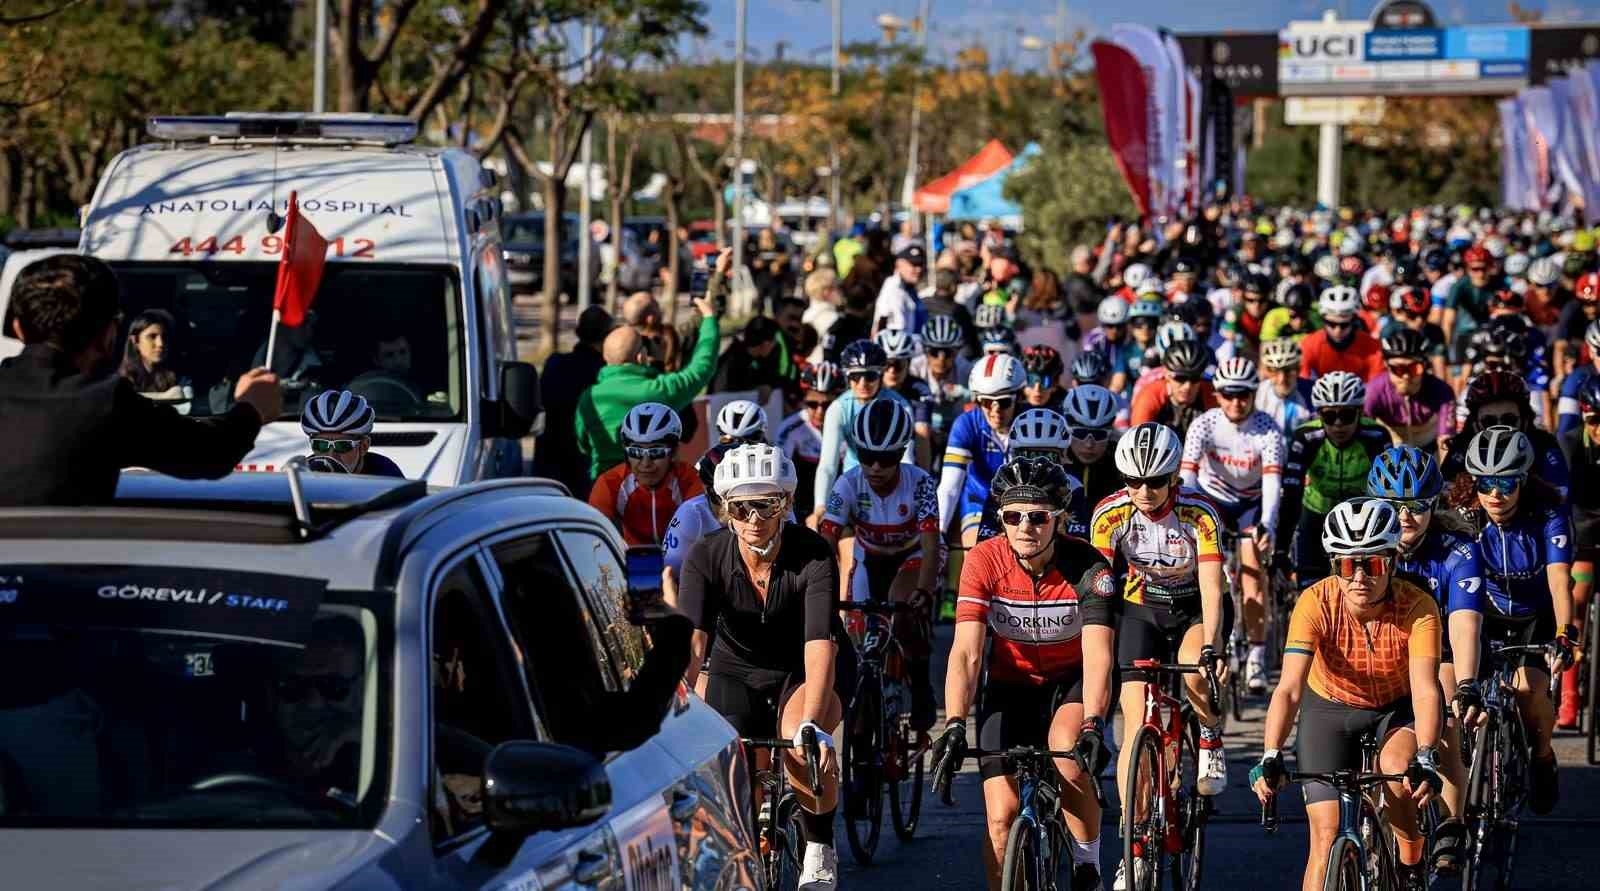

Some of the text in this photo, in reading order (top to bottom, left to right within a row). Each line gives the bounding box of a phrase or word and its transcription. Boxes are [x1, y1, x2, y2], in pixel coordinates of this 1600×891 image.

[1296, 37, 1355, 57] UCI
[141, 199, 273, 216] ANATOLIA
[169, 234, 246, 256] 444
[225, 593, 289, 611] STAFF
[996, 610, 1074, 629] DORKING
